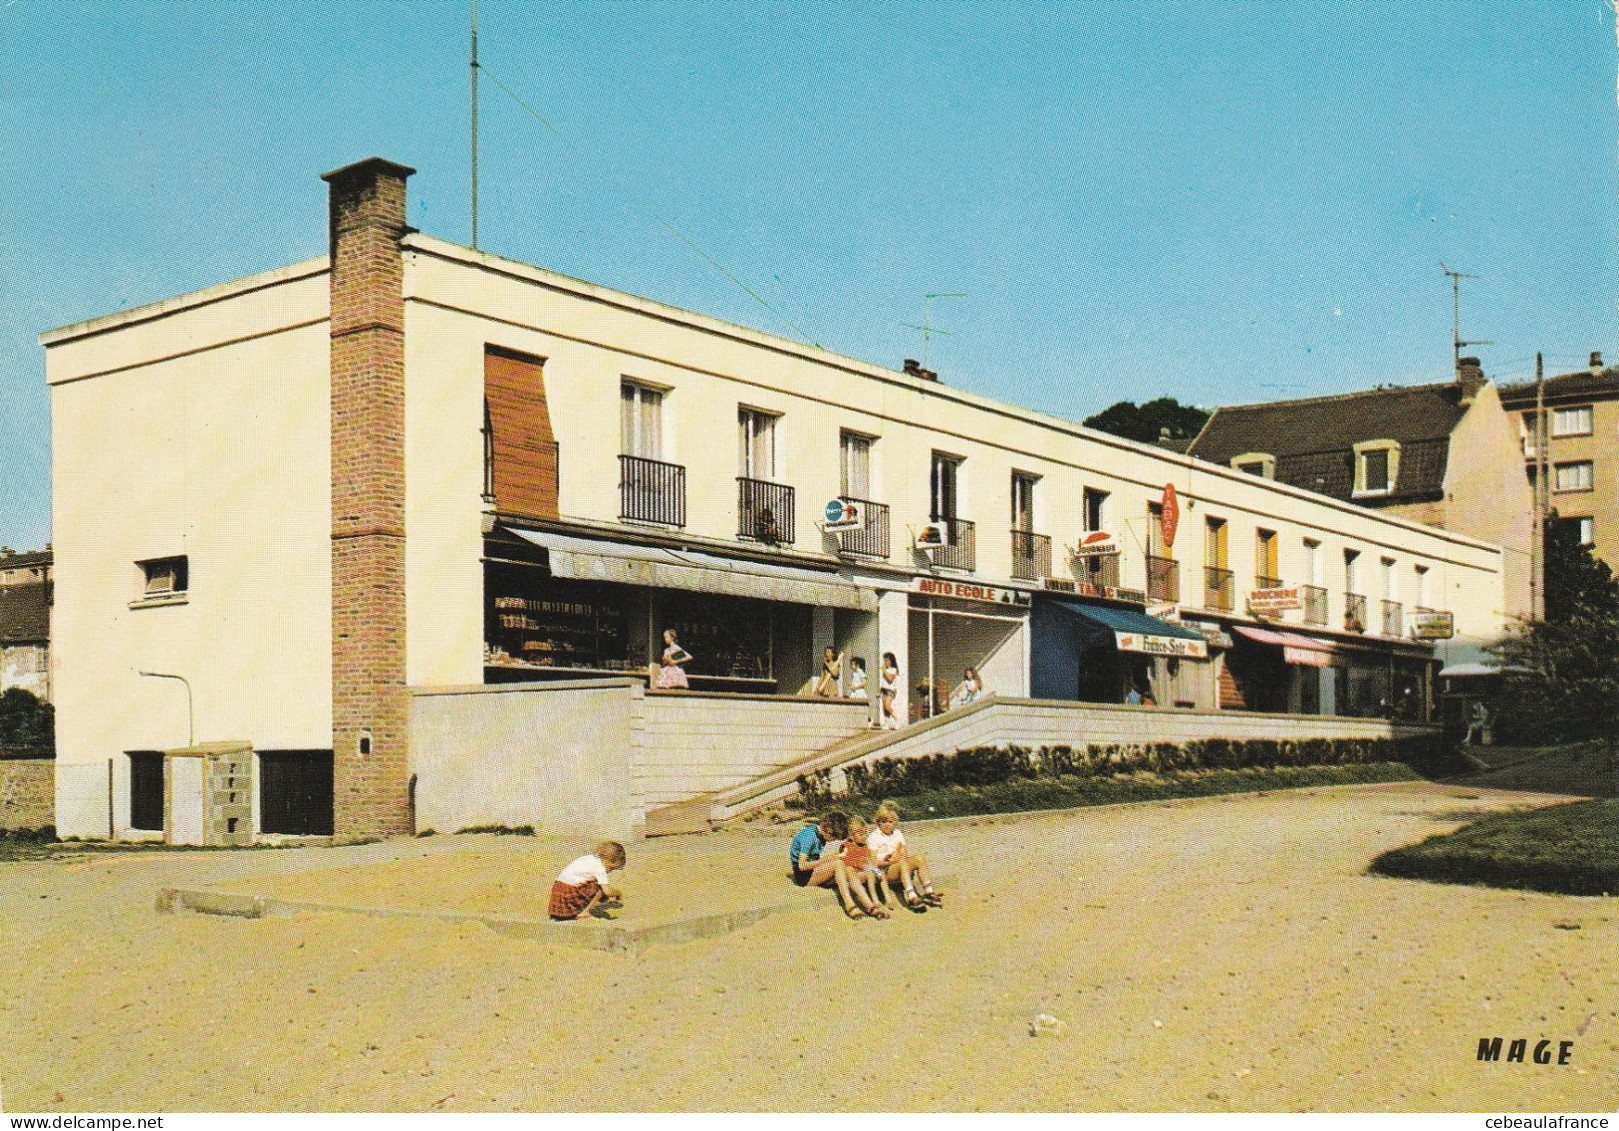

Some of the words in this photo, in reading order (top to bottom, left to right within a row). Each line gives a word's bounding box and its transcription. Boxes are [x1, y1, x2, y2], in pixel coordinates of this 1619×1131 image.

[1163, 488, 1174, 541] TABAC
[919, 579, 952, 595] AUTO
[955, 583, 996, 601] ECOLE
[1250, 589, 1297, 600] BOUCHERIE
